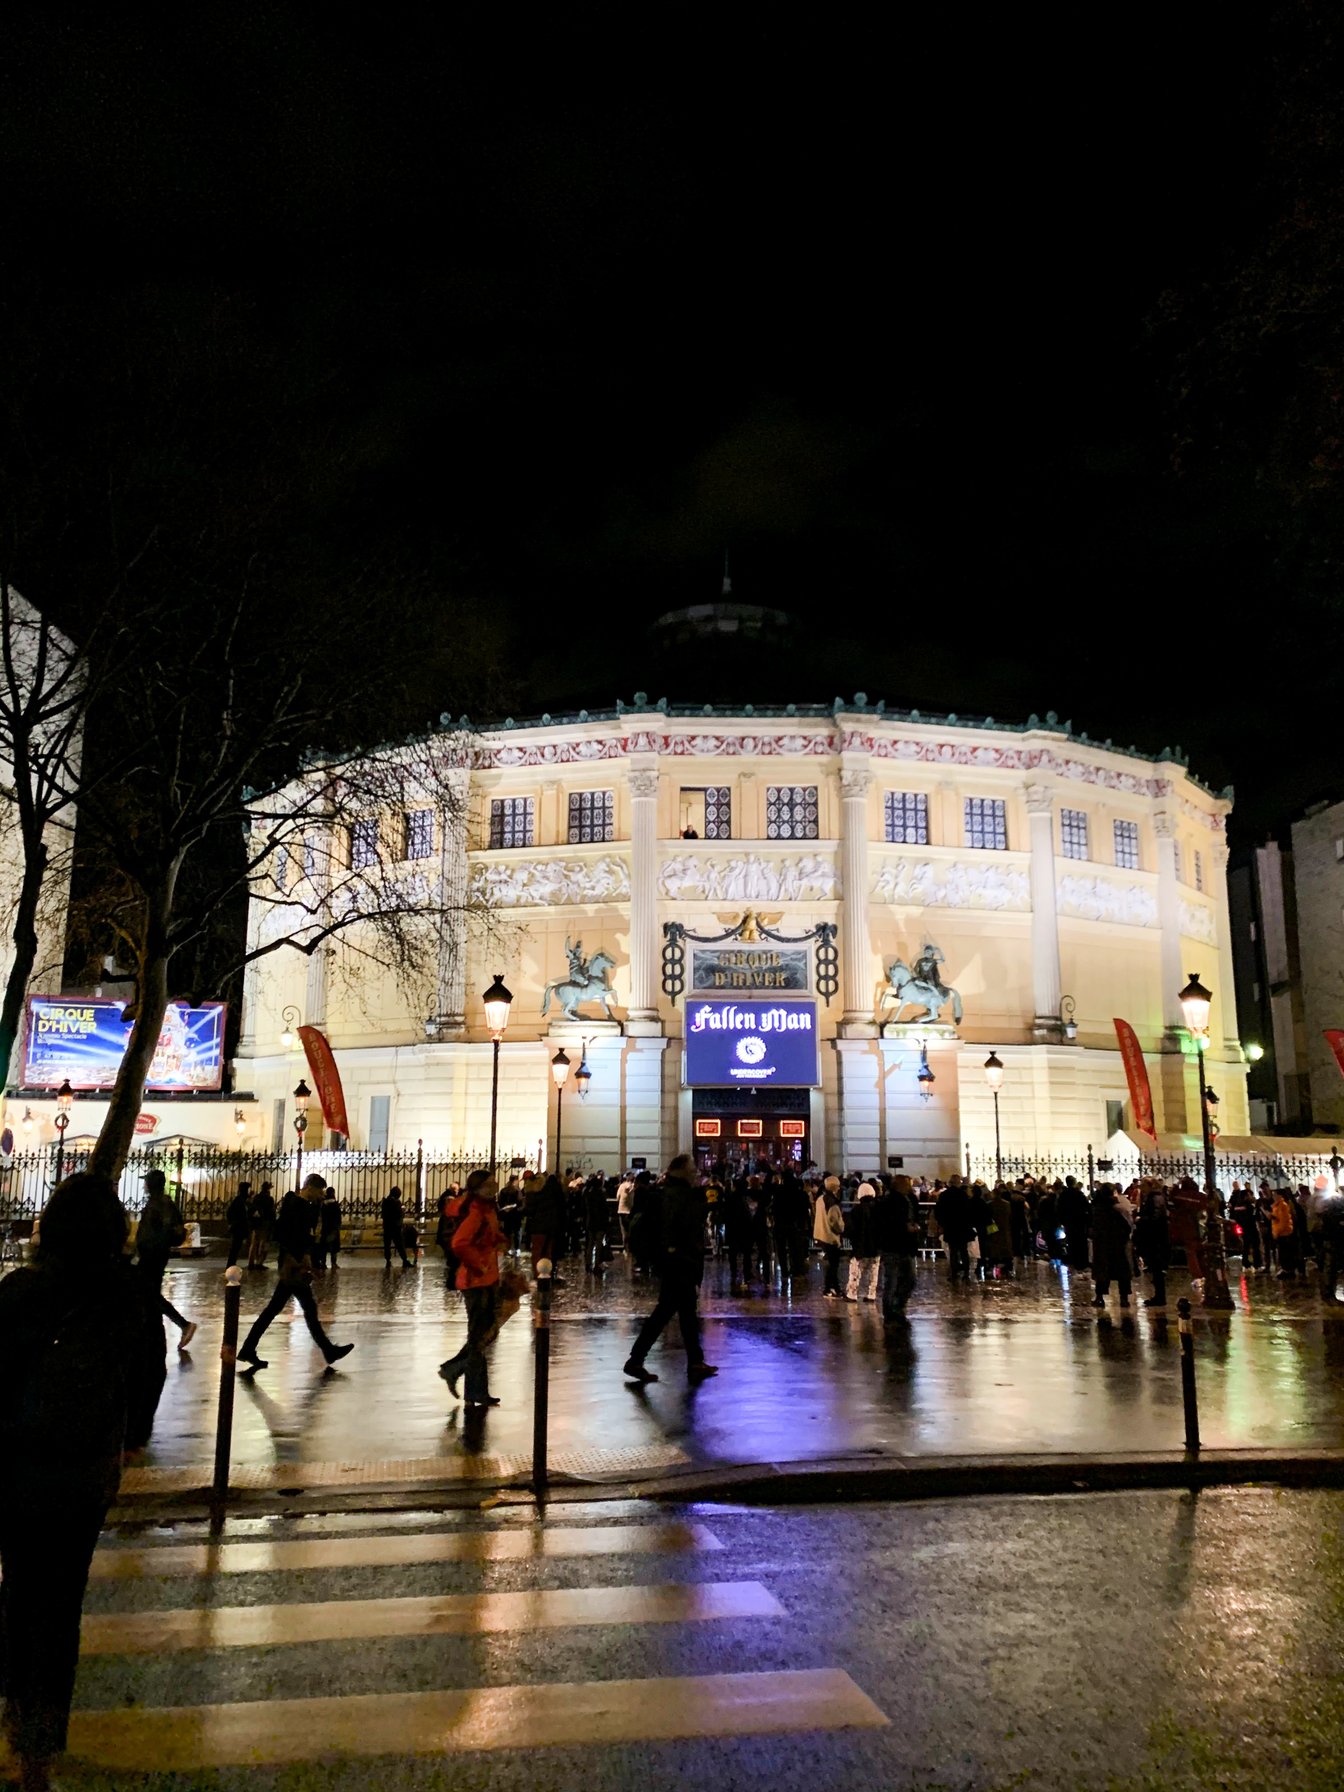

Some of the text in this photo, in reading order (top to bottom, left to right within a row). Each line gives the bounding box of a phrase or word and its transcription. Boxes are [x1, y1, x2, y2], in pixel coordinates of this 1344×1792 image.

[719, 951, 781, 969] CIRQUE
[39, 1007, 95, 1021] CIRQUE
[690, 1004, 812, 1033] Fallen Man
[37, 1019, 97, 1034] D'HIVER
